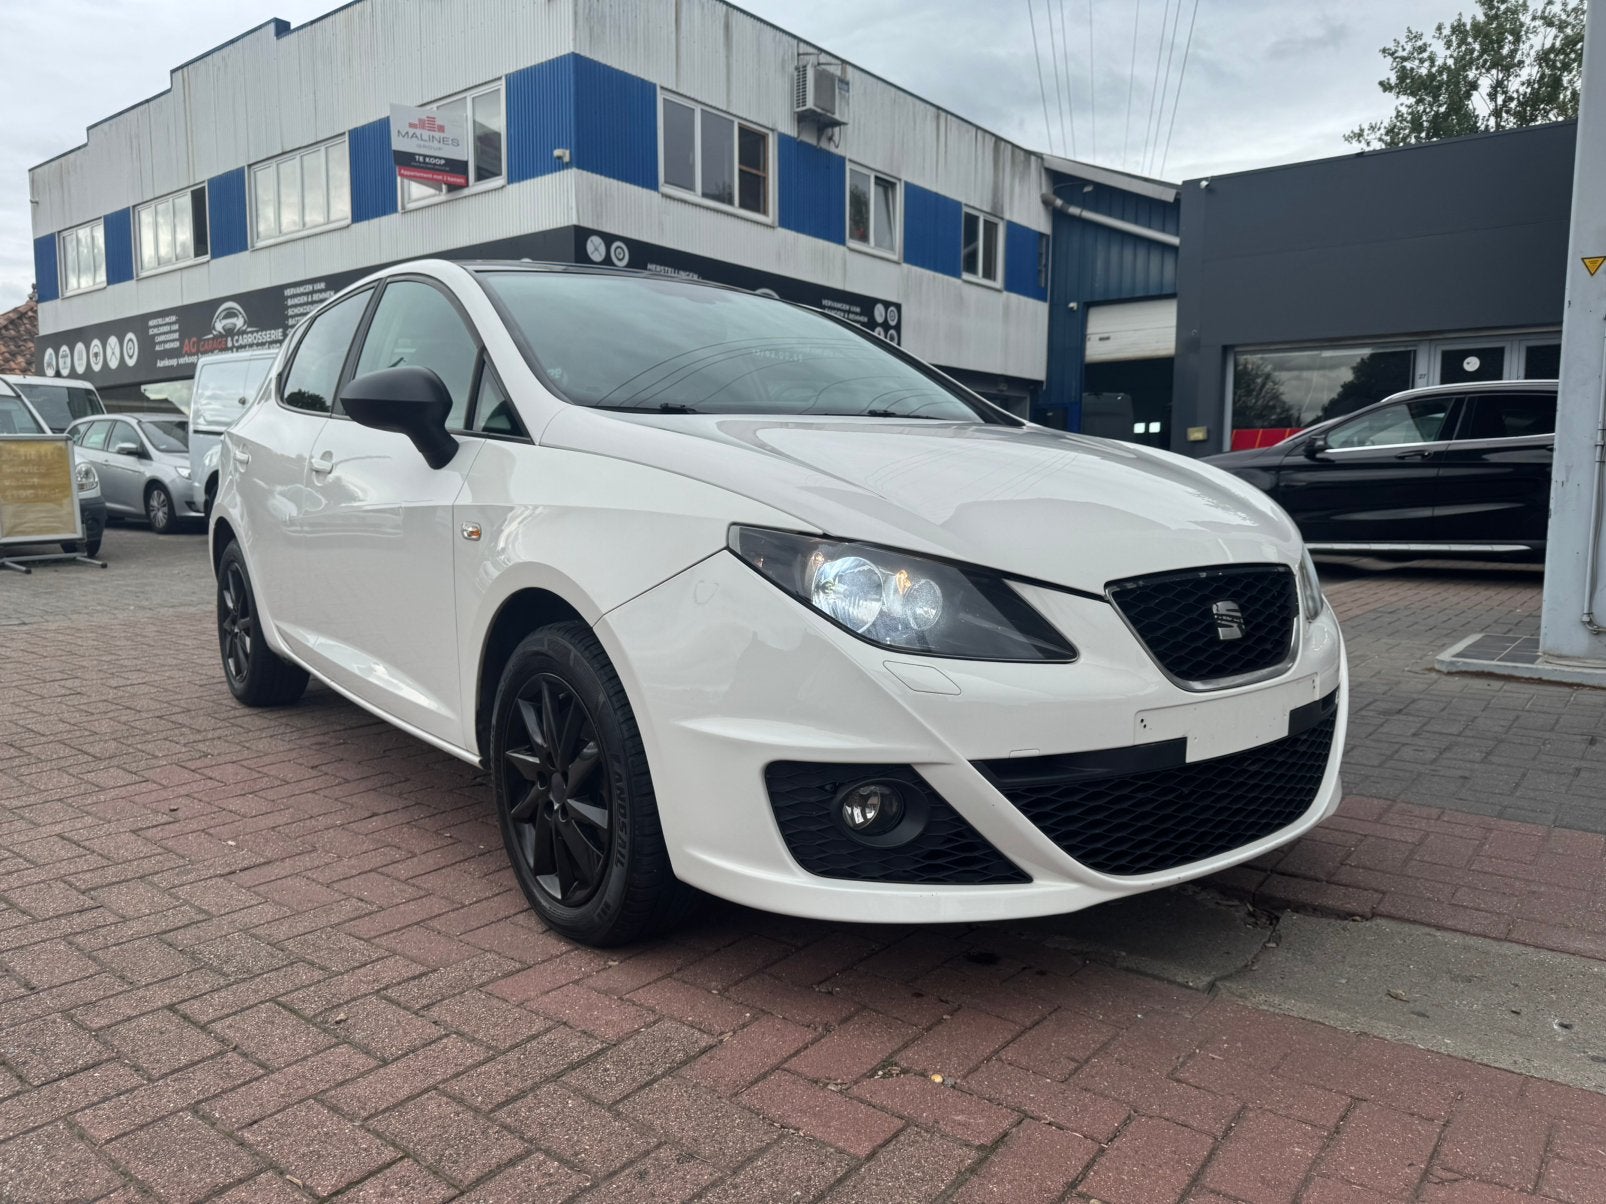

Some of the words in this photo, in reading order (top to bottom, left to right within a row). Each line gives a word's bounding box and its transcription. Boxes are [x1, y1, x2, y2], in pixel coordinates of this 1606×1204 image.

[397, 129, 461, 148] MALINES
[425, 156, 446, 165] KOOP
[647, 263, 698, 280] HERSTELLINGEN
[284, 283, 313, 297] VERVANGEN
[287, 294, 308, 306] BANDEN
[183, 337, 198, 354] AG
[199, 337, 227, 351] GARAGE
[227, 336, 232, 348] &
[233, 328, 284, 347] CARROSSERIE
[156, 356, 178, 368] Aankoop
[178, 354, 198, 366] verkoop
[608, 753, 627, 868] LANDSAIL
